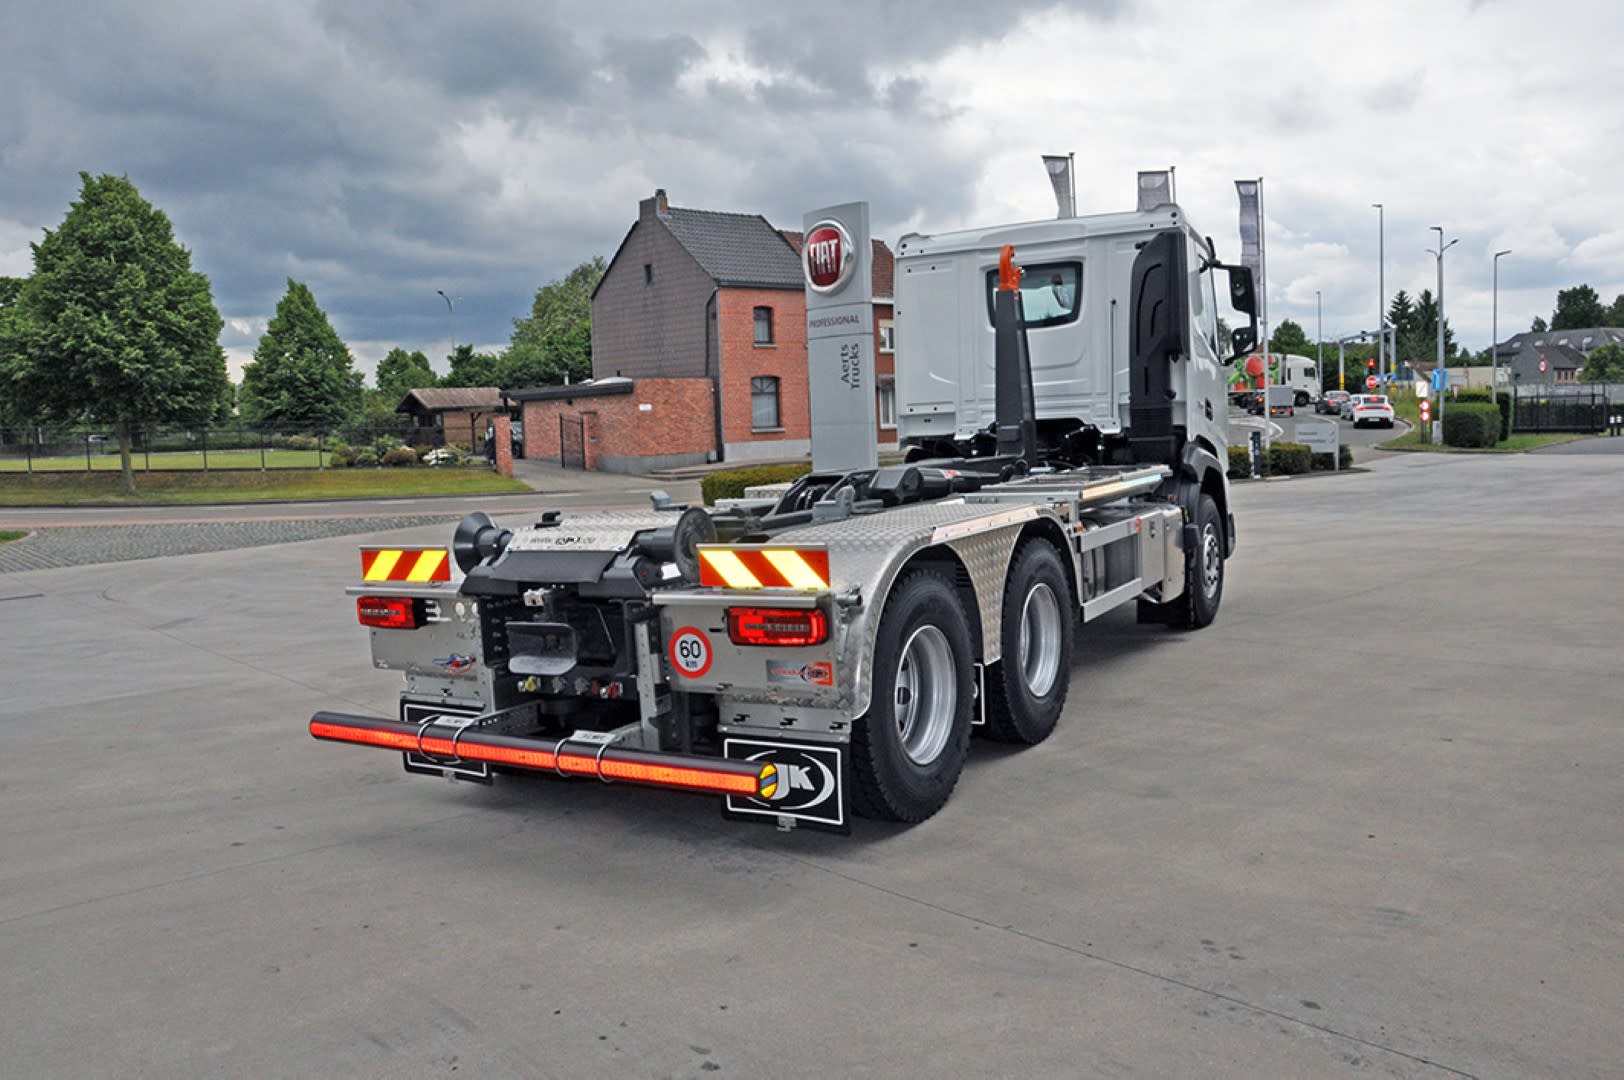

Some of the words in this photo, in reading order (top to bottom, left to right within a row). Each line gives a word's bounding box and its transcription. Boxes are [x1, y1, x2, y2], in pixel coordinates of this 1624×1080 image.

[810, 239, 838, 275] FIAT
[809, 315, 860, 328] PROFESSIONAL
[840, 344, 849, 383] Aerts
[849, 343, 860, 388] Trucks
[680, 640, 702, 658] 60
